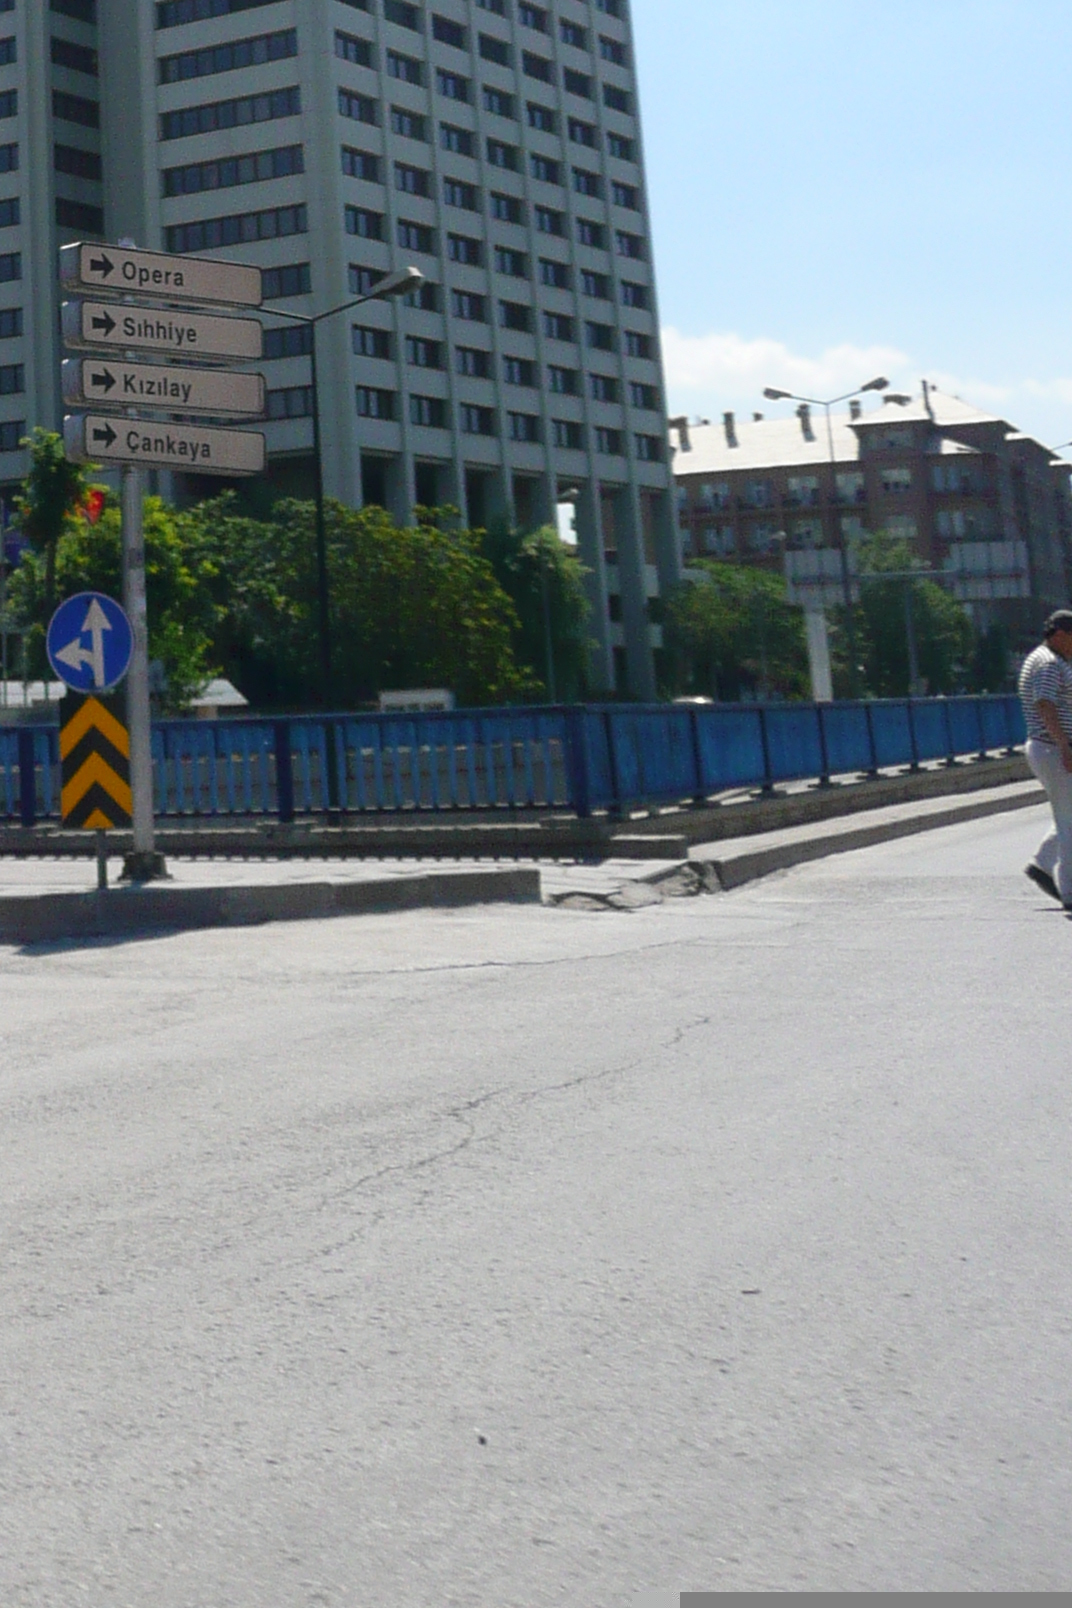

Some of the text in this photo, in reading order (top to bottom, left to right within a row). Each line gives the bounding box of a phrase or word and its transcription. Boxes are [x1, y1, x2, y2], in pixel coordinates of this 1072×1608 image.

[122, 261, 184, 287] Opera
[122, 317, 198, 345] Sıhhiye
[122, 373, 193, 403] Kızılay
[126, 430, 212, 462] Çankaya
